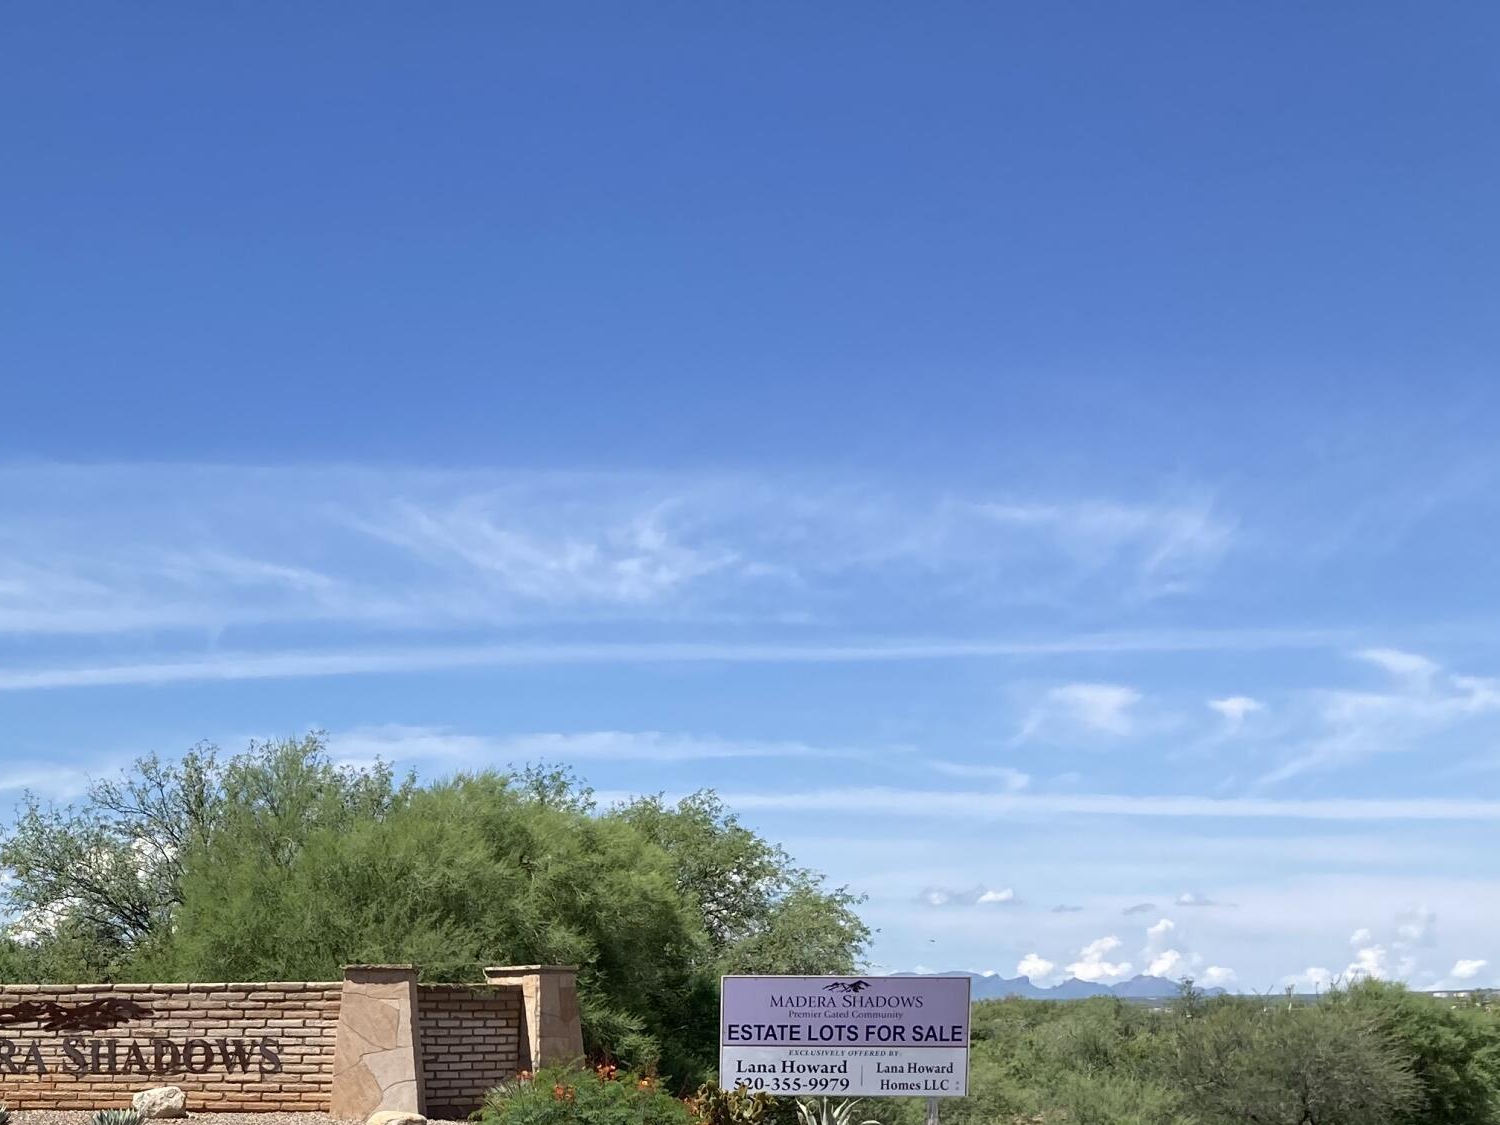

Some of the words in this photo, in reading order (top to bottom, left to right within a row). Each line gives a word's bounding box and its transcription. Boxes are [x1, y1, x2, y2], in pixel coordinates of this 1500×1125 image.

[769, 995, 836, 1008] MADERA
[842, 994, 924, 1008] SHADOWS
[788, 1010, 821, 1019] Premier
[824, 1010, 849, 1019] Gated
[851, 1010, 903, 1020] Community
[727, 1024, 801, 1042] ESTATE
[808, 1025, 858, 1042] LOTS
[865, 1025, 905, 1042] FOR
[912, 1025, 962, 1042] SALE
[62, 1036, 282, 1076] SHADOWS
[736, 1060, 776, 1073] Lana
[781, 1060, 848, 1074] Howard
[876, 1062, 904, 1073] Lana
[907, 1062, 953, 1074] Howard
[734, 1077, 850, 1091] 520-355-9979
[880, 1079, 920, 1091] Homes
[924, 1079, 949, 1091] LLC
